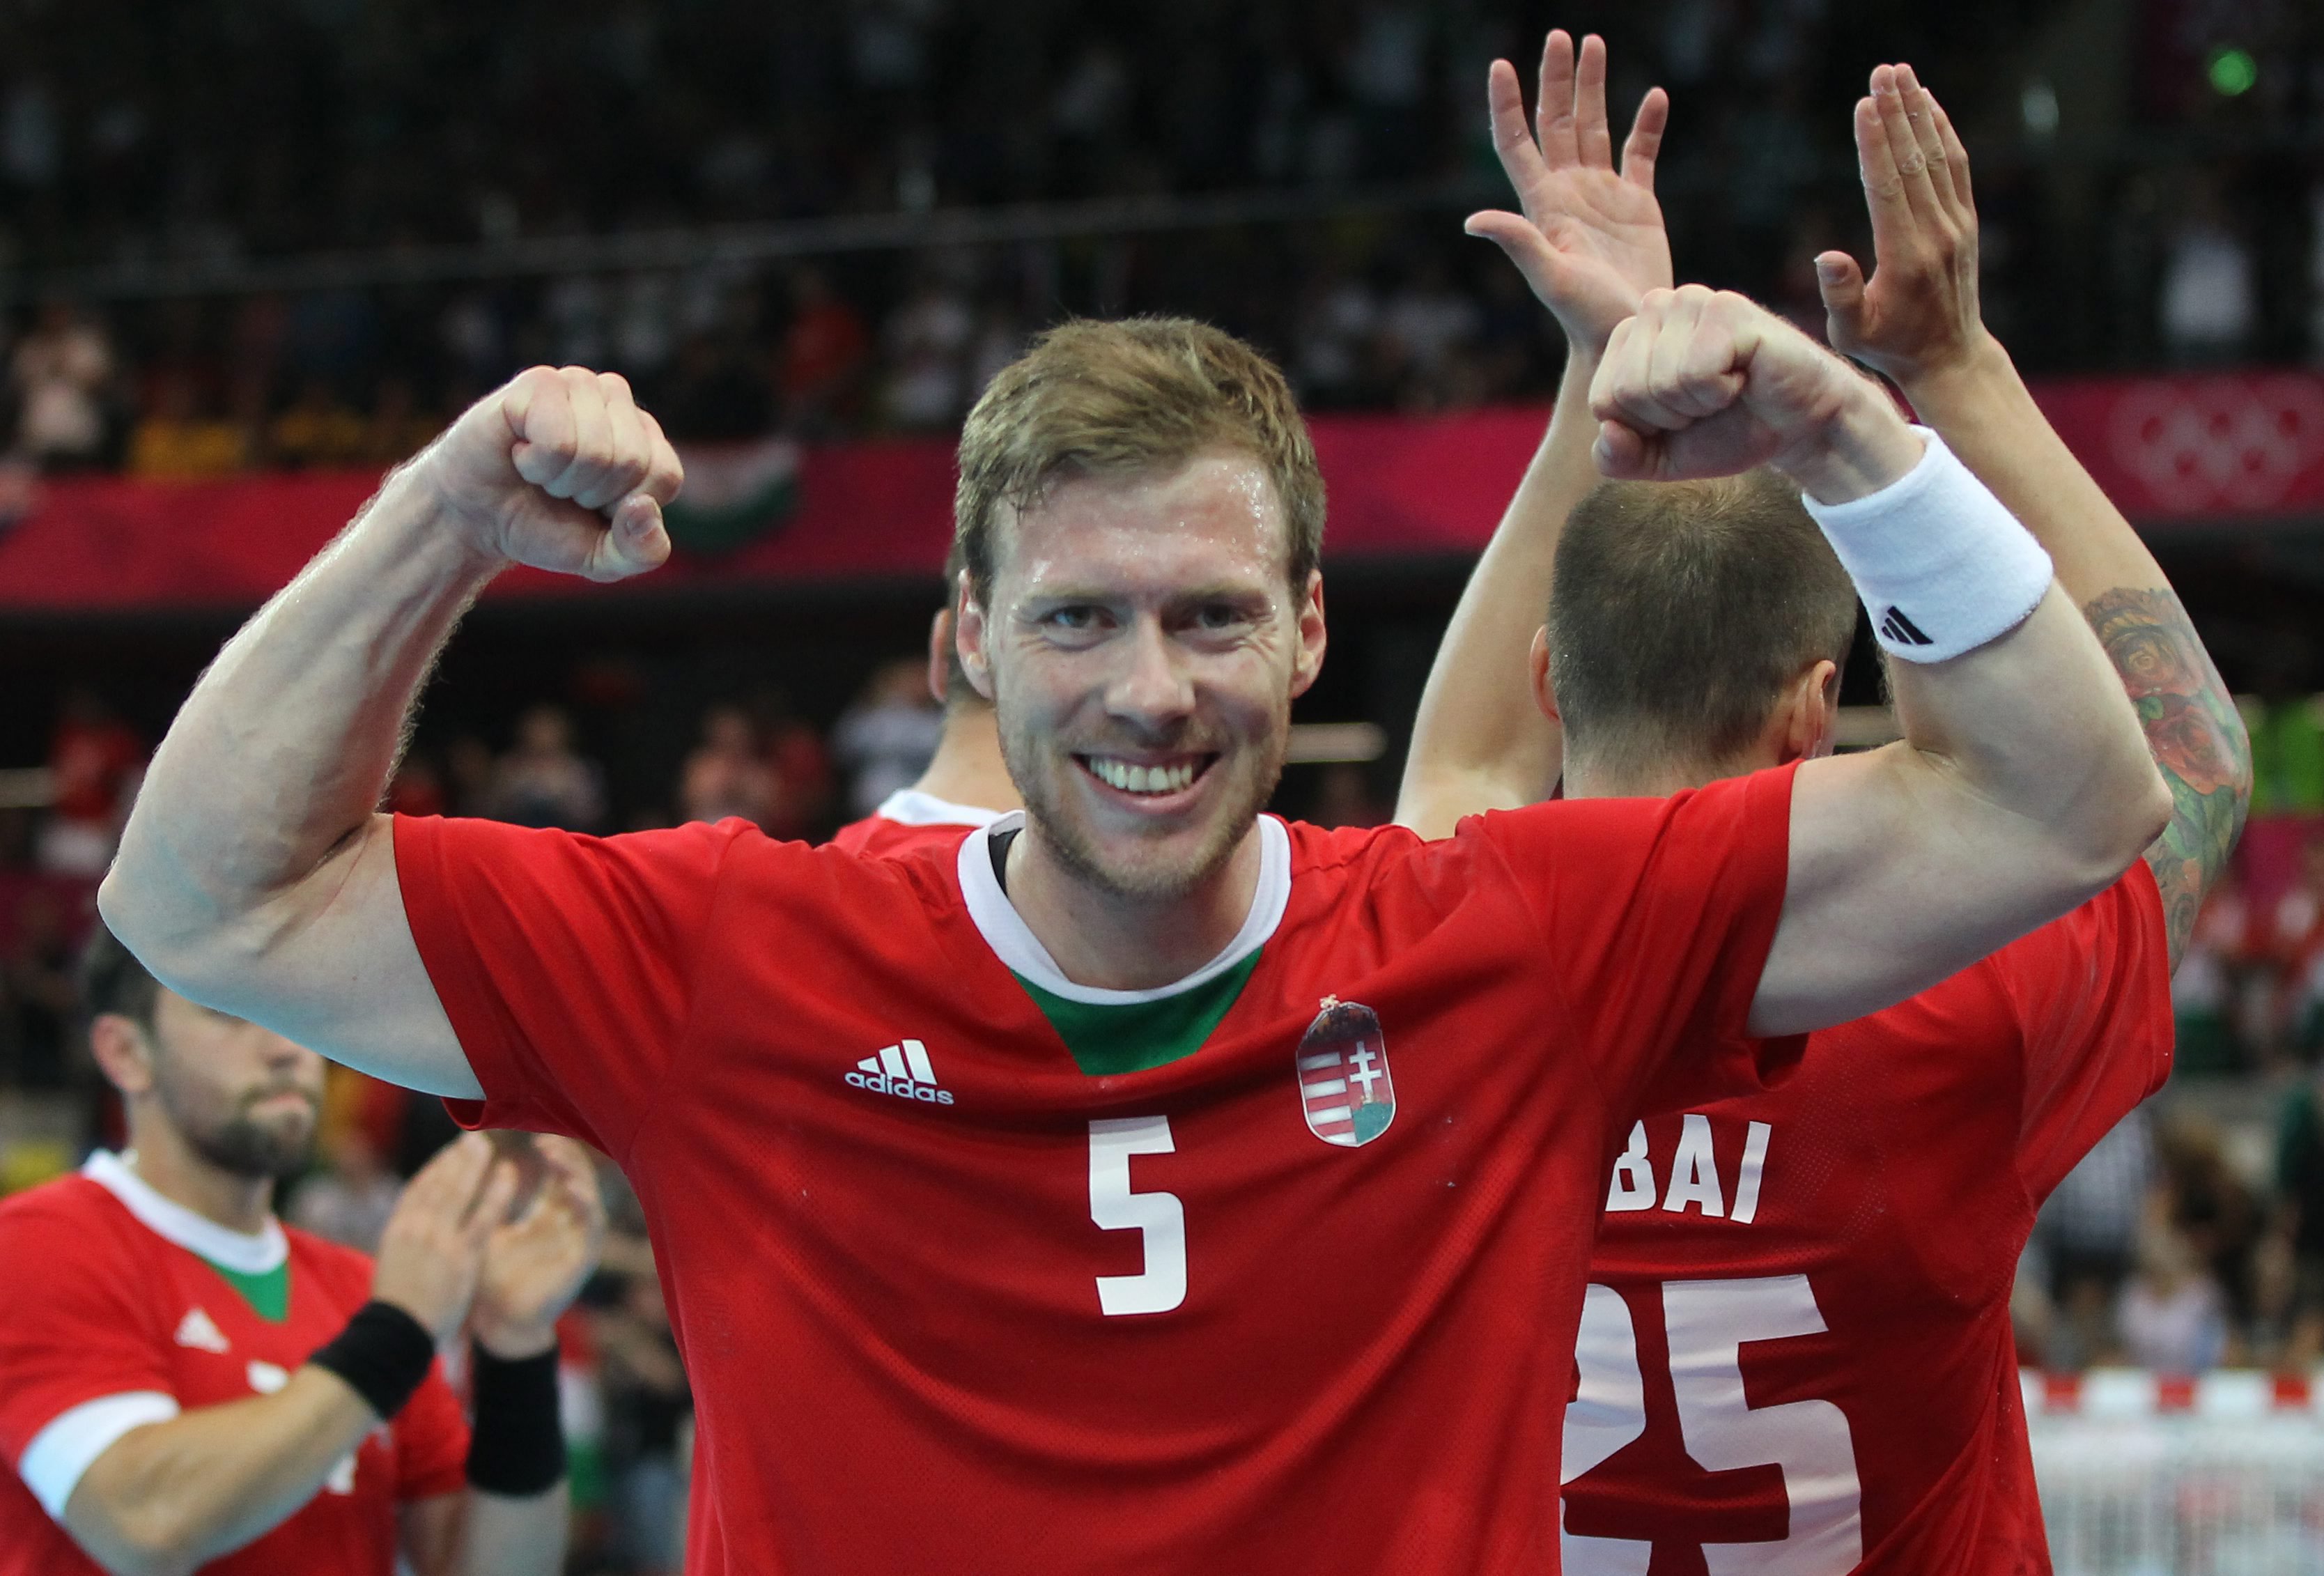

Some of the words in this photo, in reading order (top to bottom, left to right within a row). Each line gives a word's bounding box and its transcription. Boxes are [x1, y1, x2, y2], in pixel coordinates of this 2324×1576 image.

[844, 1072, 954, 1105] adidas
[1088, 1115, 1188, 1316] 5
[1604, 1113, 1772, 1224] BAI
